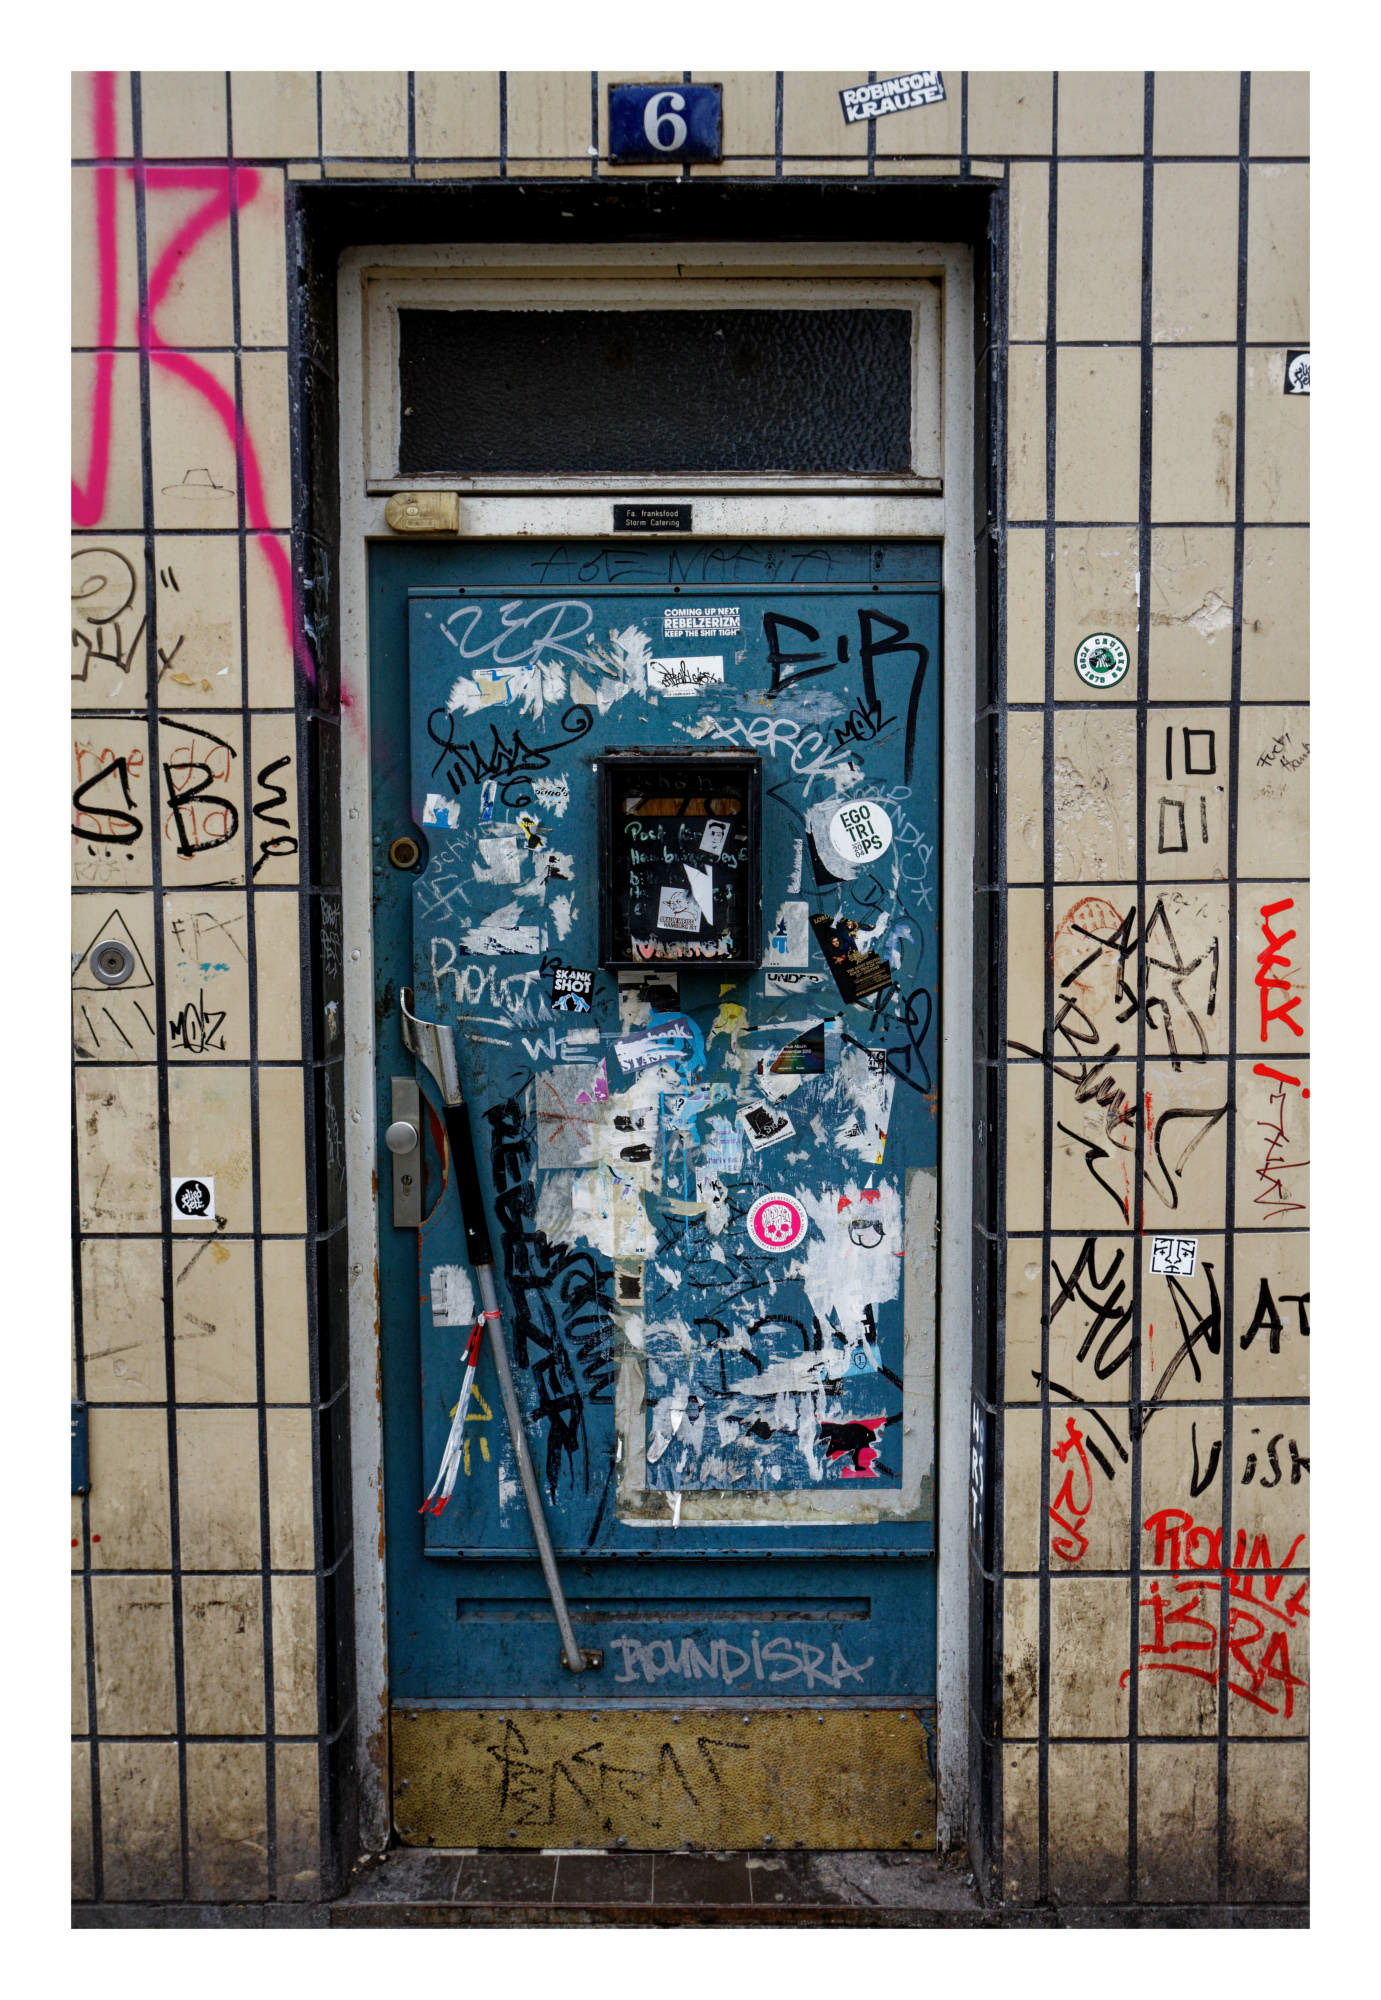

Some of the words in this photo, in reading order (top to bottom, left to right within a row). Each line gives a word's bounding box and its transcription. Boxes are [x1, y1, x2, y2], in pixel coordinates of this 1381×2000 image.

[842, 71, 938, 106] ROBINSON
[846, 86, 944, 122] KRAUSE
[643, 91, 687, 152] 6
[625, 518, 647, 527] Storm
[650, 518, 680, 528] Catering
[664, 608, 702, 617] COMING
[704, 607, 717, 616] UP
[717, 607, 740, 615] NEXT
[664, 616, 740, 629] REBELZERIZM
[664, 629, 684, 638] KEEP
[685, 629, 699, 637] THE
[700, 629, 717, 637] SHIT
[718, 629, 741, 637] TIGH
[839, 804, 871, 829] EGO
[845, 820, 876, 843] TRI
[861, 835, 883, 855] PS
[556, 968, 593, 983] SKANK
[554, 977, 592, 994] SHOT
